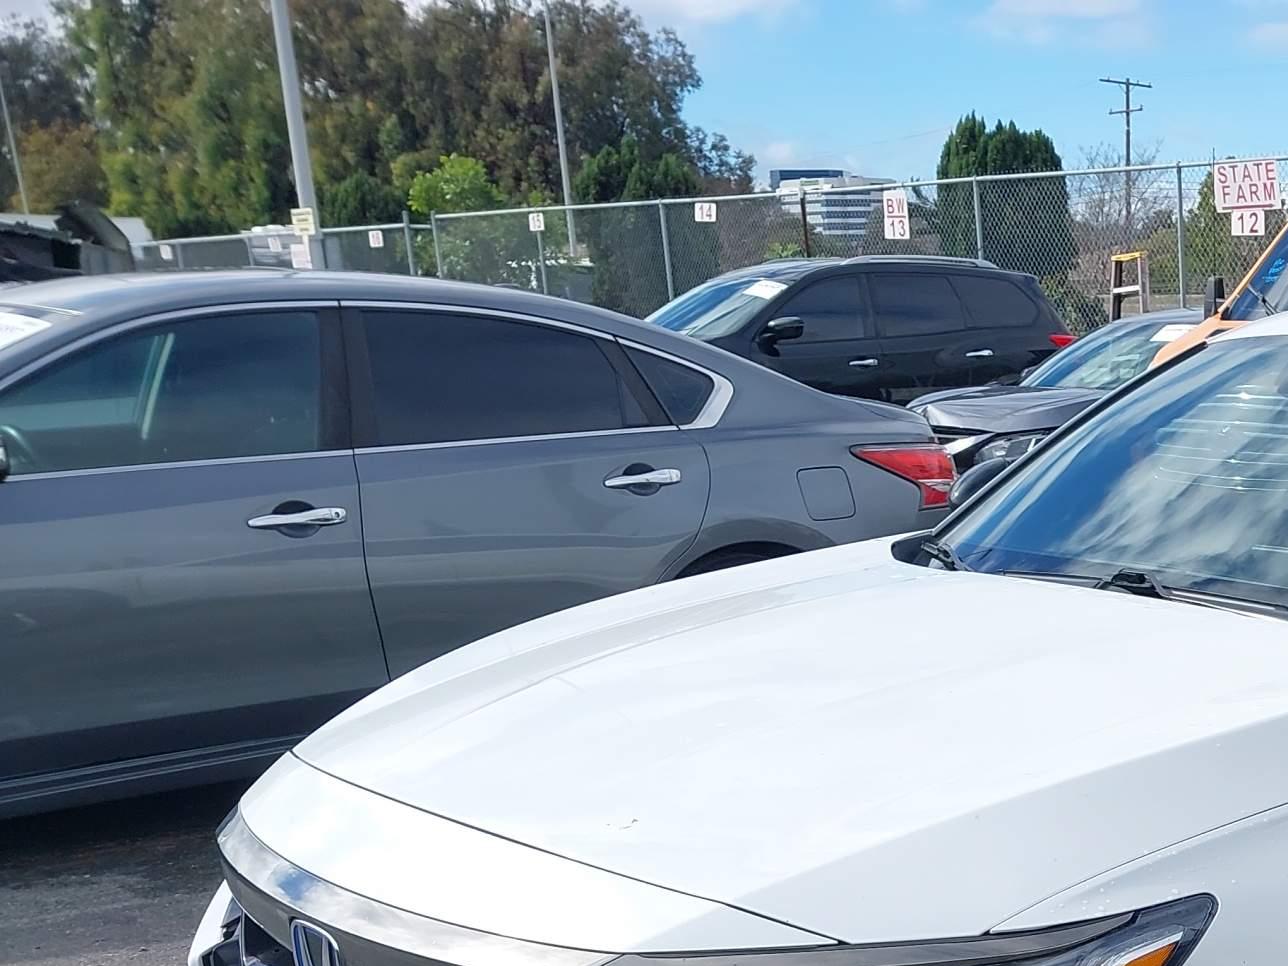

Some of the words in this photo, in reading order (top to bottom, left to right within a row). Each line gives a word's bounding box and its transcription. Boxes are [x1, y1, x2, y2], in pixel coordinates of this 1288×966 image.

[1217, 162, 1276, 184] STATE
[1222, 182, 1276, 204] FARM
[698, 204, 713, 221] 14
[886, 198, 905, 214] BW
[531, 215, 542, 229] 15
[890, 219, 906, 237] 13
[1237, 212, 1259, 234] 12
